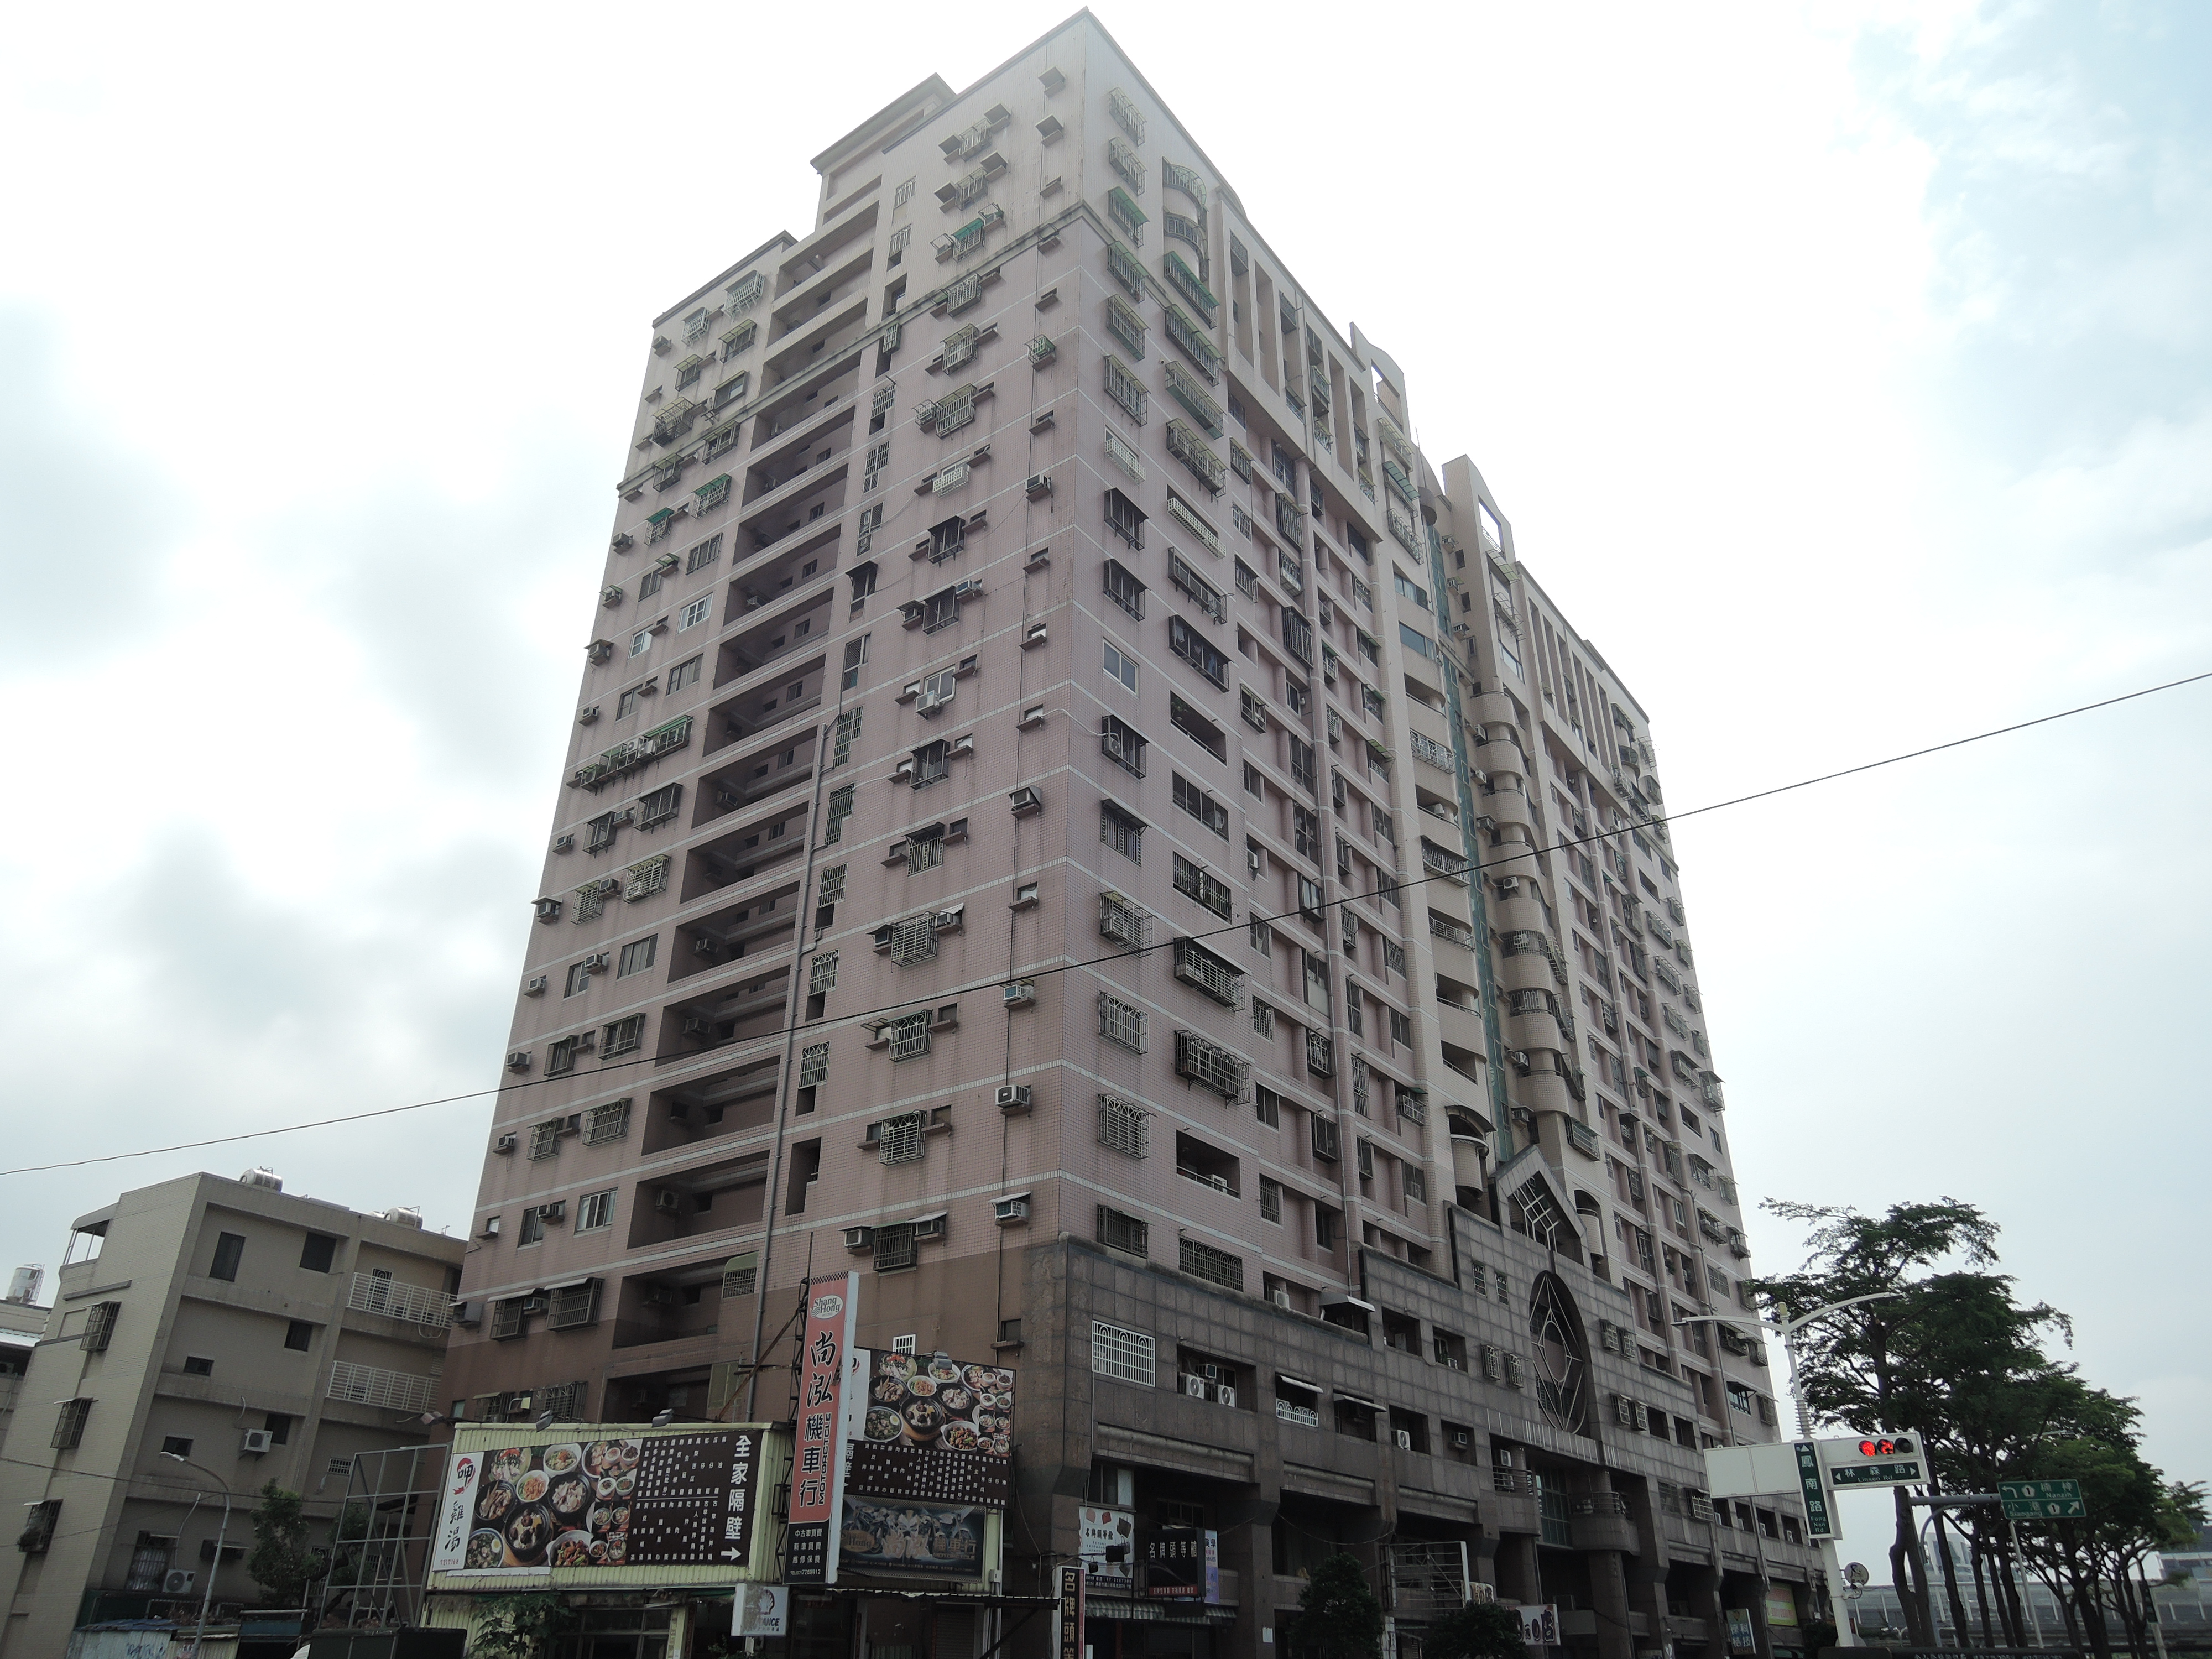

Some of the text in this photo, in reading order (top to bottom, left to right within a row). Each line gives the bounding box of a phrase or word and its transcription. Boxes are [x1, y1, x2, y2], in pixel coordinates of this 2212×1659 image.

[813, 1297, 837, 1307] Shang
[820, 1303, 841, 1313] Hong
[1844, 1464, 1906, 1478] 林森路
[724, 1434, 752, 1540] 全家隔壁
